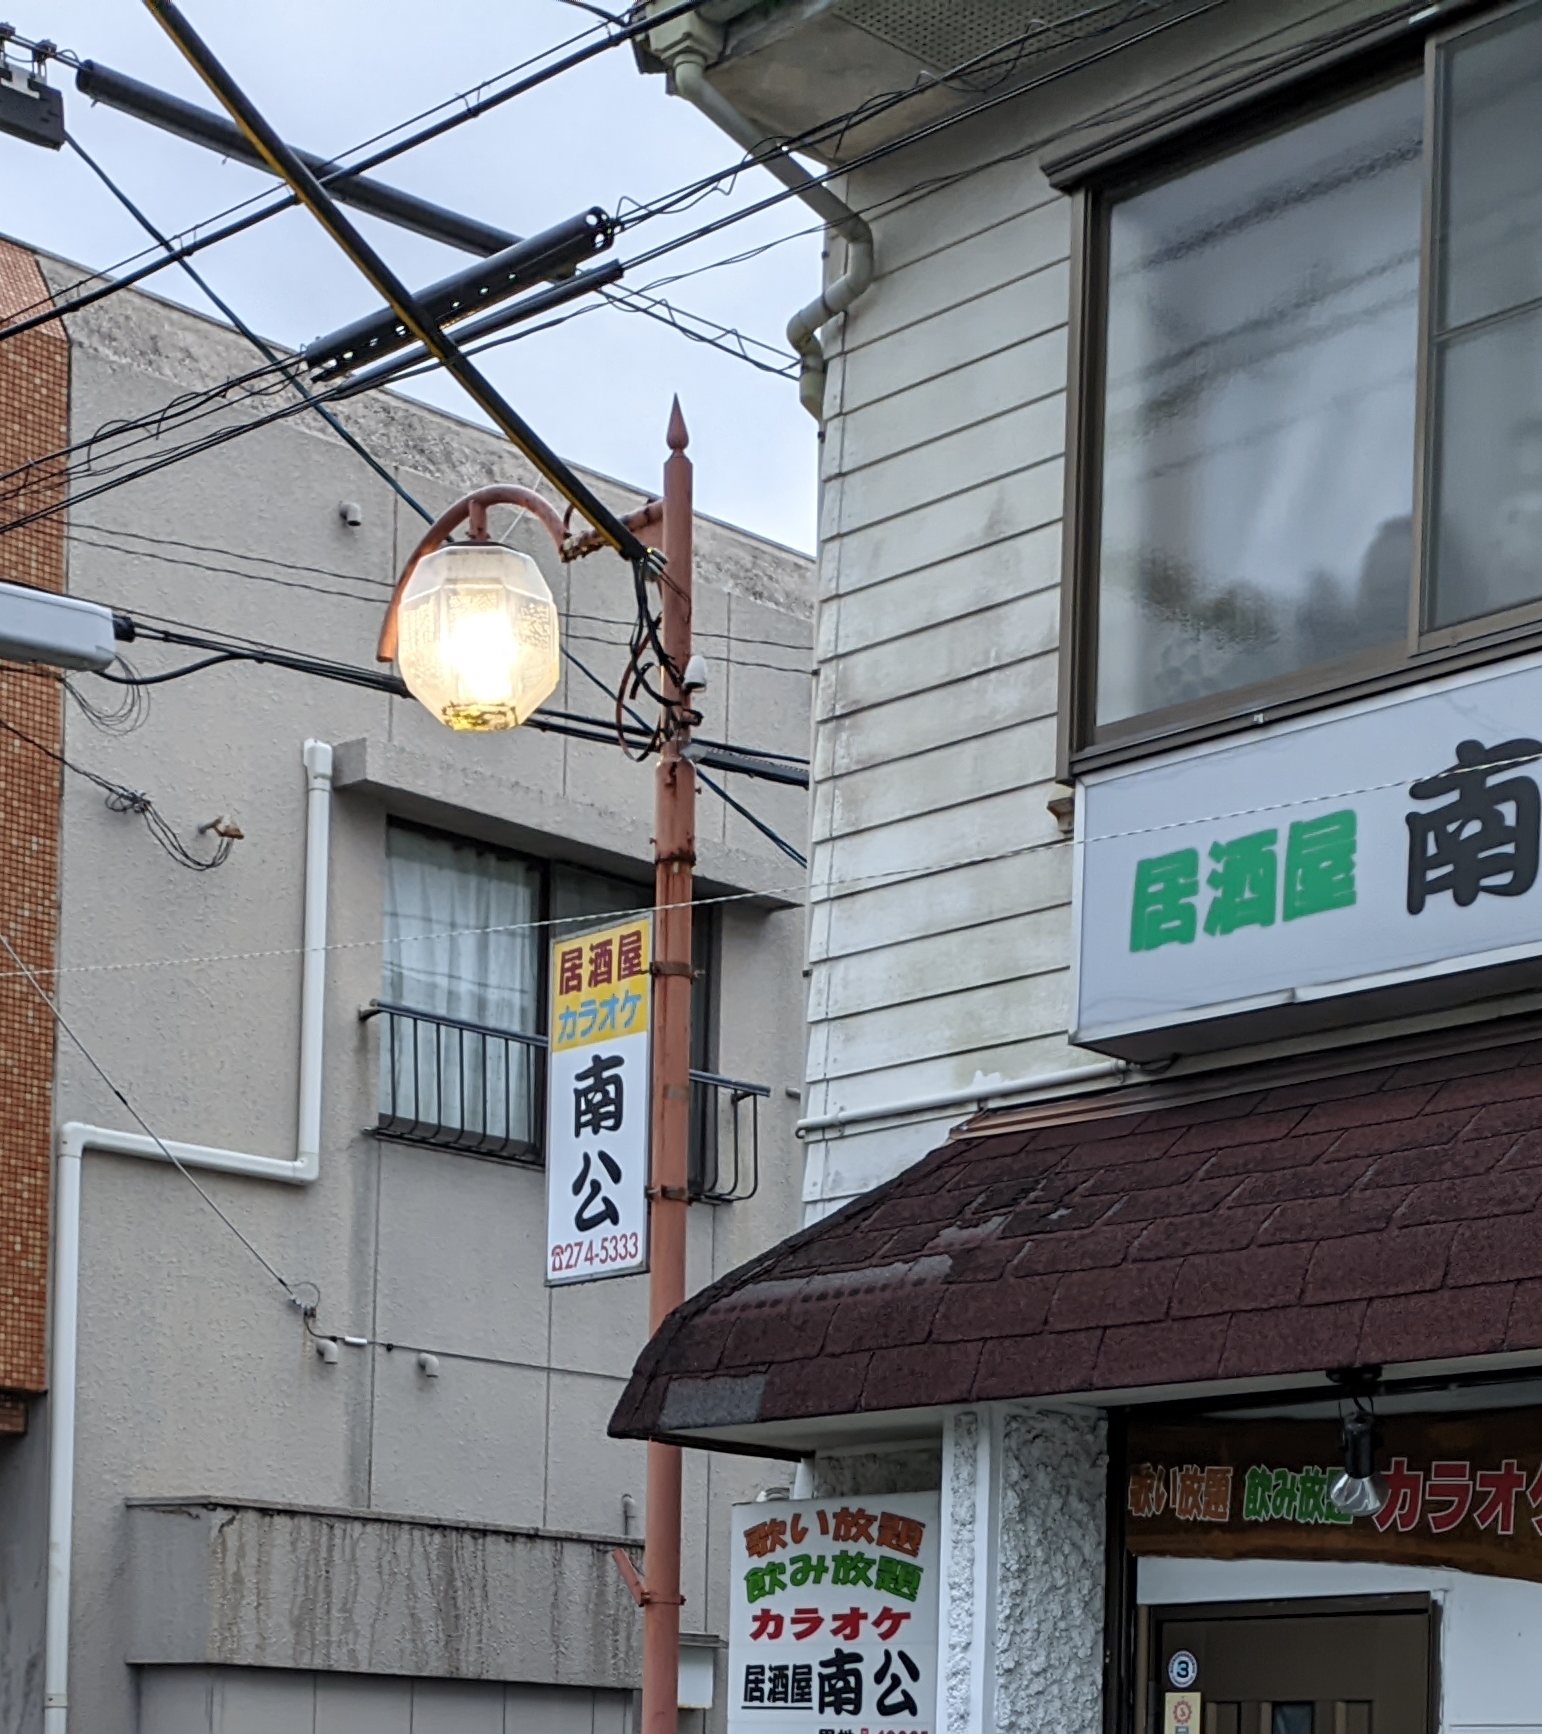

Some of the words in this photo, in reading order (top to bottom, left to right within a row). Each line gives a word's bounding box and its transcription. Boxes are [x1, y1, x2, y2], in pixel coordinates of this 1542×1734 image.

[1129, 809, 1358, 953] 居酒屋
[558, 929, 643, 995] 居酒屋
[558, 989, 643, 1043] カラオケ
[571, 1054, 627, 1233] 南公
[564, 1232, 640, 1272] 274-5333
[1128, 1462, 1233, 1523] 歌い放題
[743, 1507, 927, 1558] 歌い放題
[743, 1550, 924, 1603] 飲み放題
[749, 1606, 912, 1641] カラオケ
[743, 1664, 814, 1705] 居酒屋
[818, 1647, 921, 1717] 南公
[1176, 1660, 1190, 1679] 3
